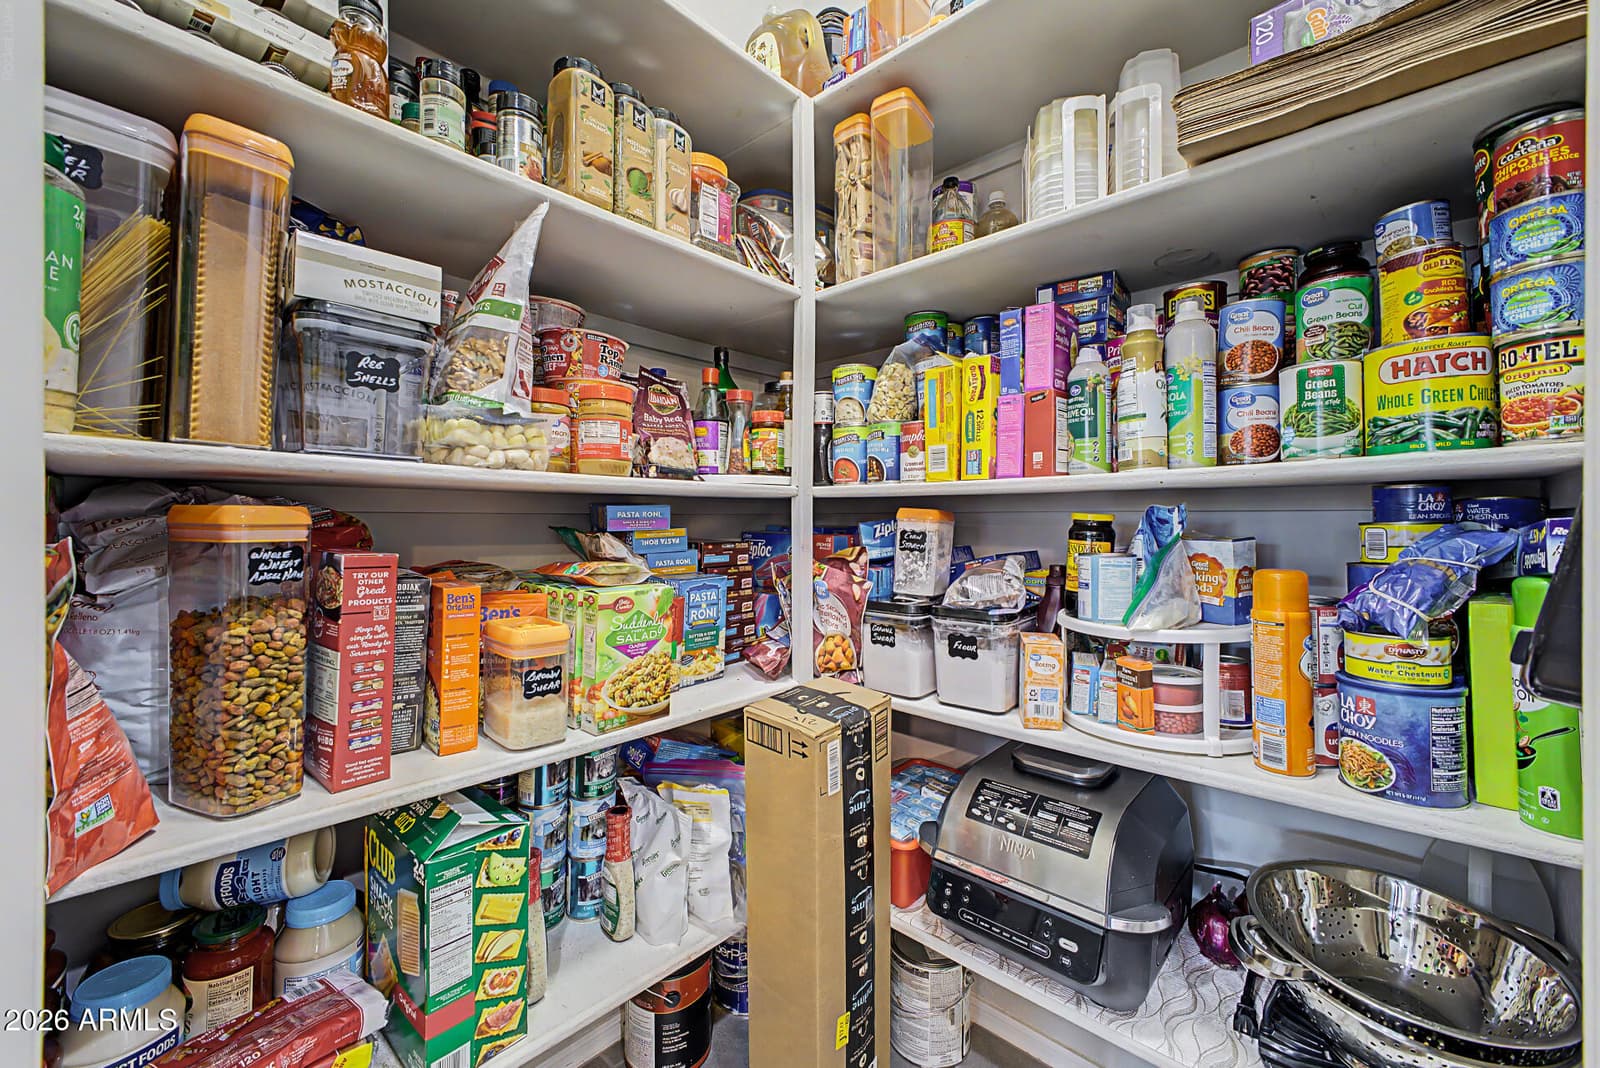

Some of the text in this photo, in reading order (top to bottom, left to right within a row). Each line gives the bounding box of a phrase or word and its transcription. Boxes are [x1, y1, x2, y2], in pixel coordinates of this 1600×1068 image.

[1255, 15, 1274, 46] 120
[1508, 204, 1568, 229] ORTEGA
[344, 278, 439, 308] MOSTACCIOLI
[1502, 276, 1557, 298] ORTEGA
[1306, 314, 1333, 325] Green
[1252, 325, 1275, 333] Beans
[599, 343, 619, 359] Top
[1391, 351, 1487, 380] HATCH
[1505, 364, 1565, 381] Original
[1304, 378, 1337, 389] Green
[1521, 381, 1564, 390] TOMATOES
[1304, 389, 1337, 401] Beans
[644, 412, 683, 424] Baby Reds
[1418, 493, 1434, 502] LA
[1418, 502, 1445, 512] CHOY
[641, 538, 659, 546] RONI
[250, 551, 292, 560] WHOLE
[259, 559, 301, 571] WHEAT
[656, 559, 674, 567] PASTA
[1194, 571, 1219, 585] king
[356, 585, 387, 598] Great
[690, 591, 717, 602] PASTA
[348, 597, 392, 606] PRODUCTS
[447, 592, 476, 605] Ben's
[446, 602, 476, 612] Original
[480, 605, 520, 622] Ben's
[691, 609, 717, 621] RONI
[610, 611, 665, 634] Suddenly
[616, 629, 657, 644] SALAD
[1388, 646, 1426, 655] DYNASTY
[1367, 665, 1443, 679] Water Chestnuts
[1341, 692, 1355, 710] LA
[1358, 697, 1374, 715] 東
[1341, 708, 1377, 730] CHOY
[1361, 734, 1404, 749] NOODLES
[1000, 833, 1036, 860] NINJA
[368, 829, 396, 885] CLUB
[220, 866, 236, 897] FOODS
[430, 882, 456, 894] Nutrition
[139, 1034, 176, 1066] FOODS
